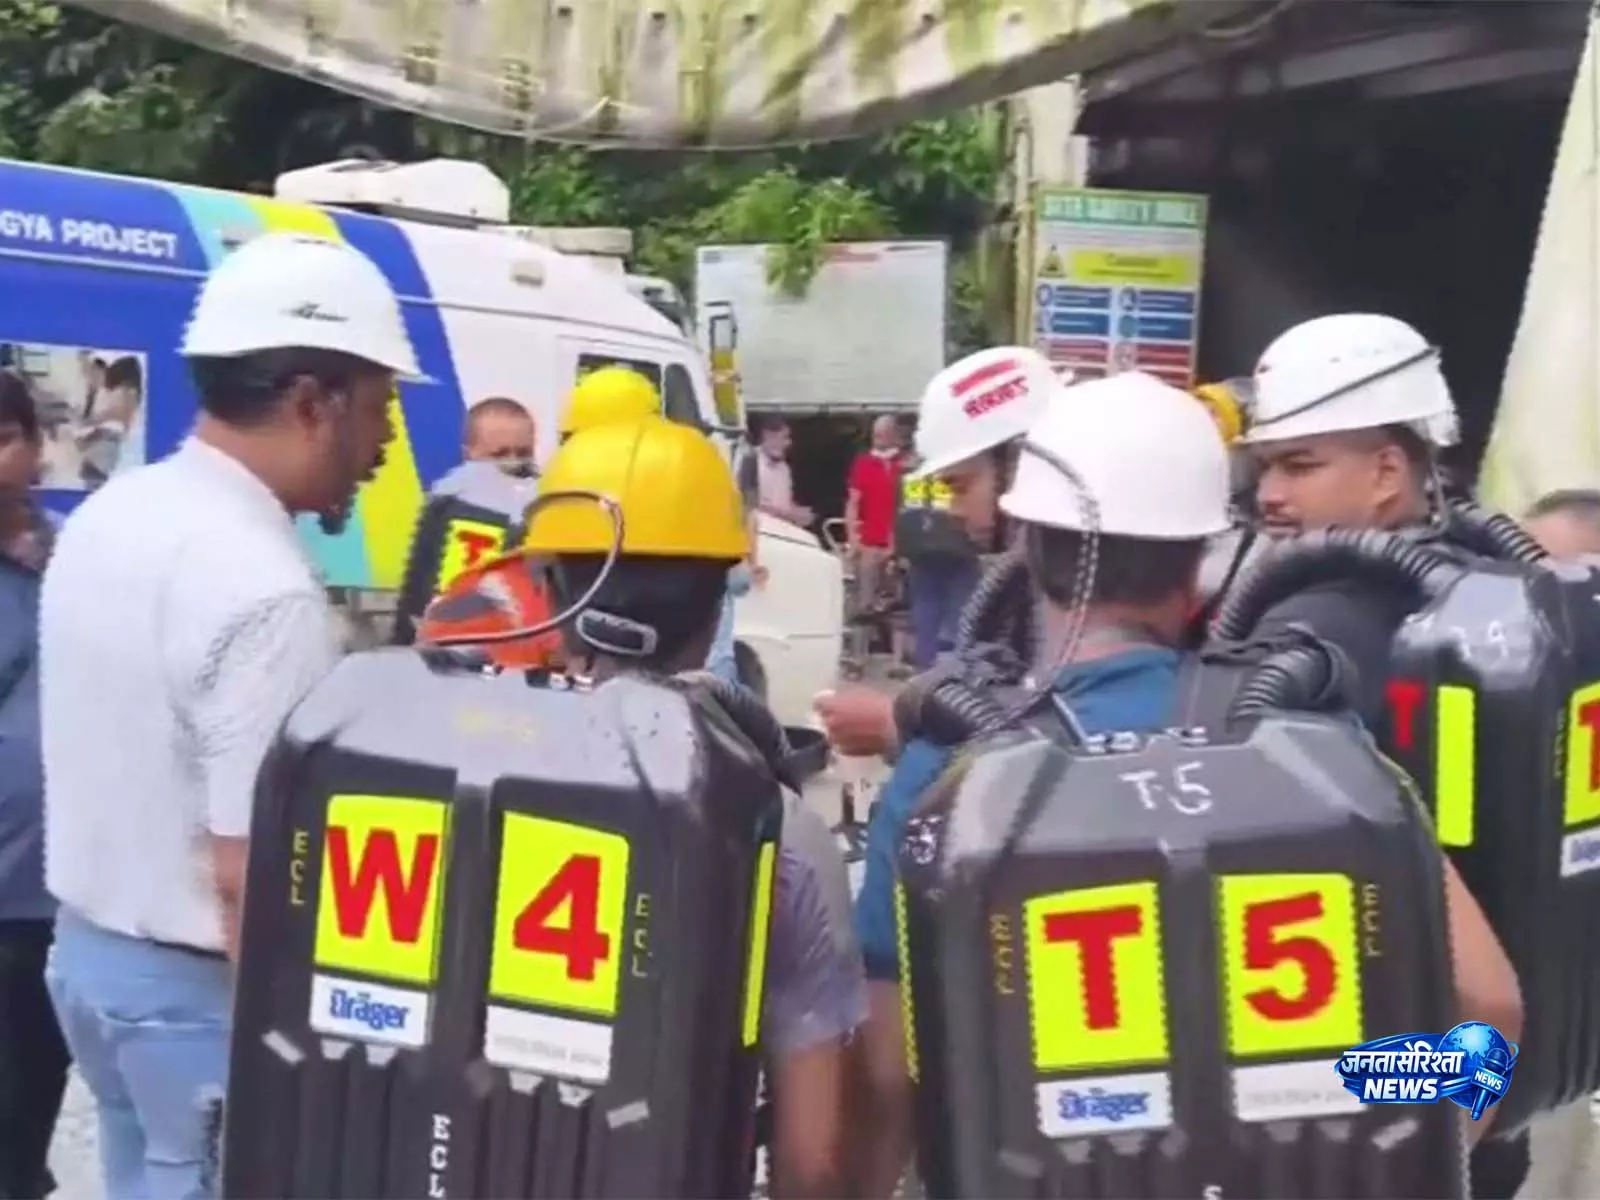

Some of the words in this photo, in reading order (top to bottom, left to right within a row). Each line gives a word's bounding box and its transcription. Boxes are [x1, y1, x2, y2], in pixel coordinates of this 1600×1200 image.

[60, 217, 177, 259] PROJECT
[1386, 678, 1425, 748] T
[290, 829, 309, 906] ECL
[325, 826, 439, 945] W
[512, 853, 611, 982] 4
[632, 892, 652, 978] ECL
[1043, 904, 1143, 1031] T
[1243, 891, 1338, 1022] 5
[428, 1113, 452, 1199] ECL
